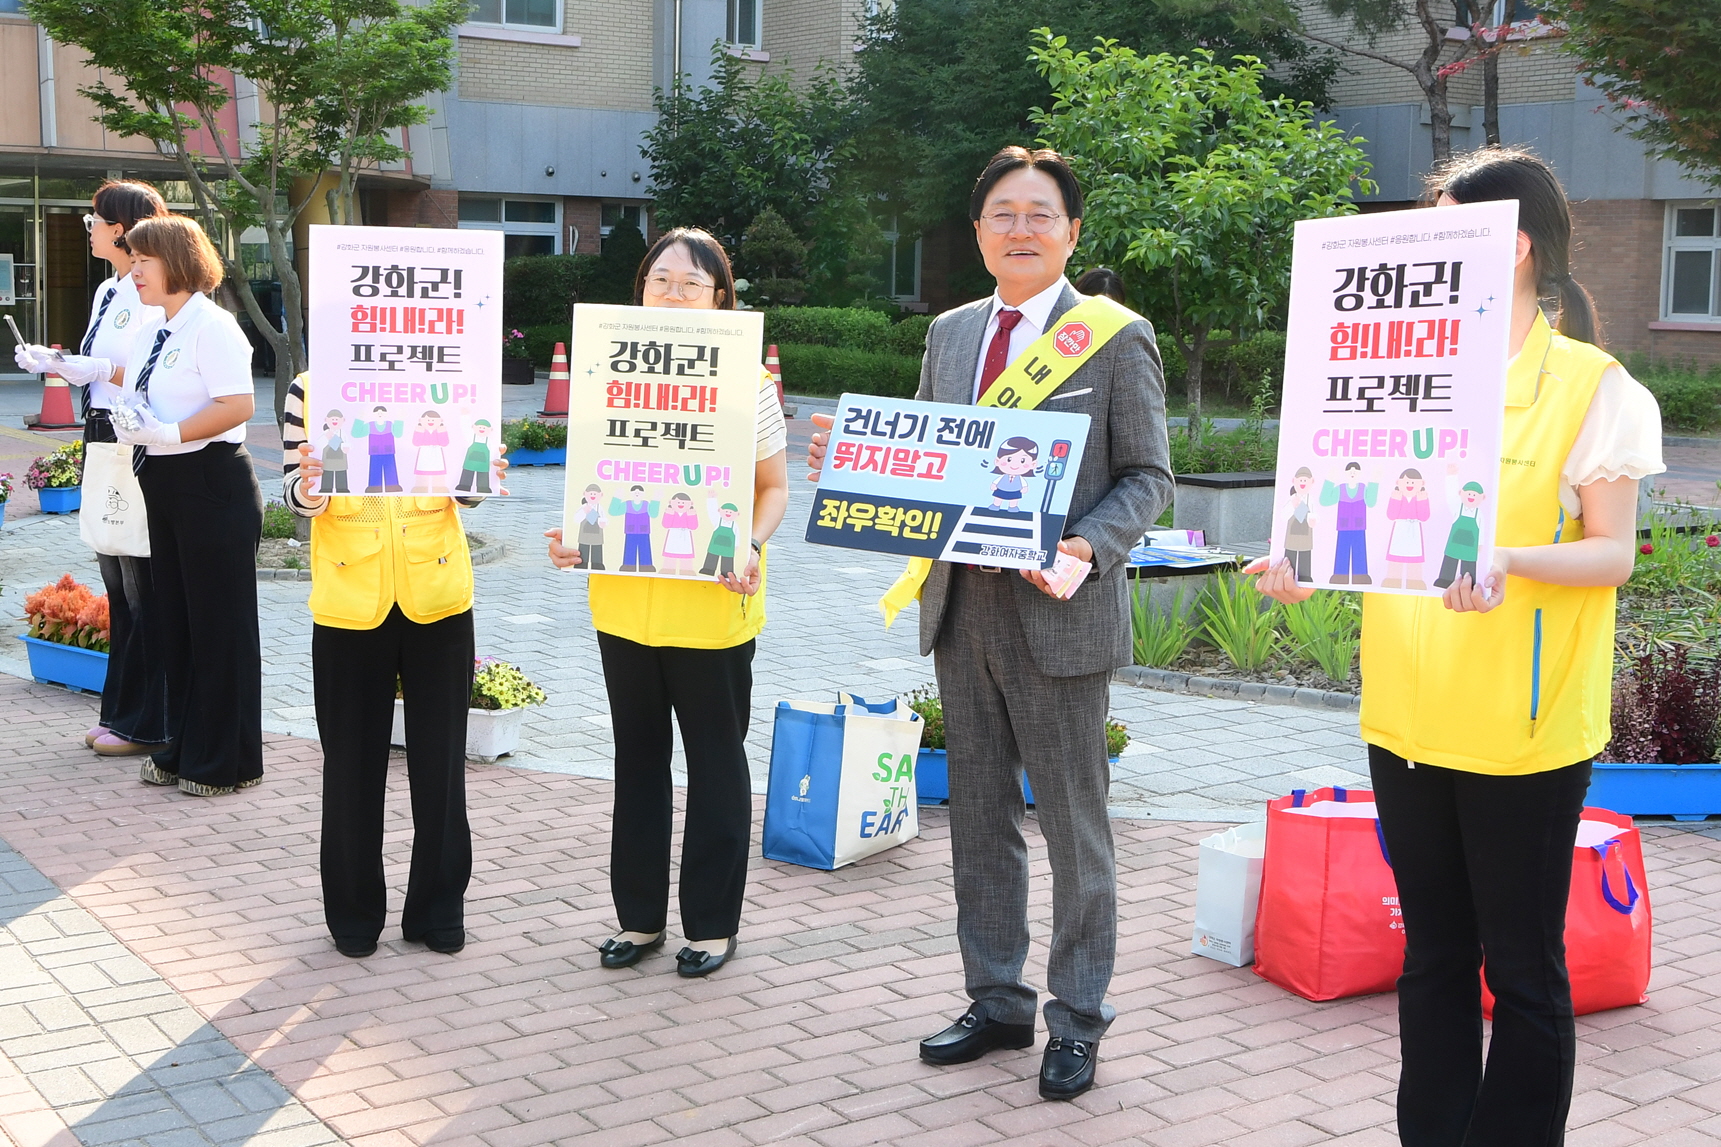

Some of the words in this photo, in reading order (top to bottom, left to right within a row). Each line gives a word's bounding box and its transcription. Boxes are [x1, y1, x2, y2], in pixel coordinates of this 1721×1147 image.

[1321, 239, 1346, 250] #강화군
[1347, 236, 1389, 248] 자원봉사센터
[1390, 232, 1432, 244] #응원합니다.
[1433, 227, 1491, 241] #함께하겠습니다.
[350, 264, 463, 299] 강화군!
[1333, 261, 1463, 312] 강화군!
[350, 304, 465, 335] 힘!내!라!
[1057, 331, 1081, 354] 잠깐만
[1329, 318, 1461, 361] 힘!내!라!
[348, 343, 463, 372] 프로젝트
[609, 340, 720, 377] 강화군!
[341, 381, 427, 403] CHEER
[430, 382, 477, 404] UP!
[605, 379, 718, 413] 힘!내!라!
[1323, 373, 1453, 413] 프로젝트
[603, 418, 716, 452] 프로젝트
[843, 407, 930, 443] 건너기
[936, 416, 996, 450] 전에
[1312, 428, 1408, 458] CHEER
[1412, 427, 1469, 459] UP!
[596, 459, 680, 485] CHEER
[683, 464, 731, 488] UP!
[832, 441, 949, 481] 뛰지말고
[816, 498, 943, 541] 좌우확인!
[980, 545, 1048, 562] 강화여자중학교
